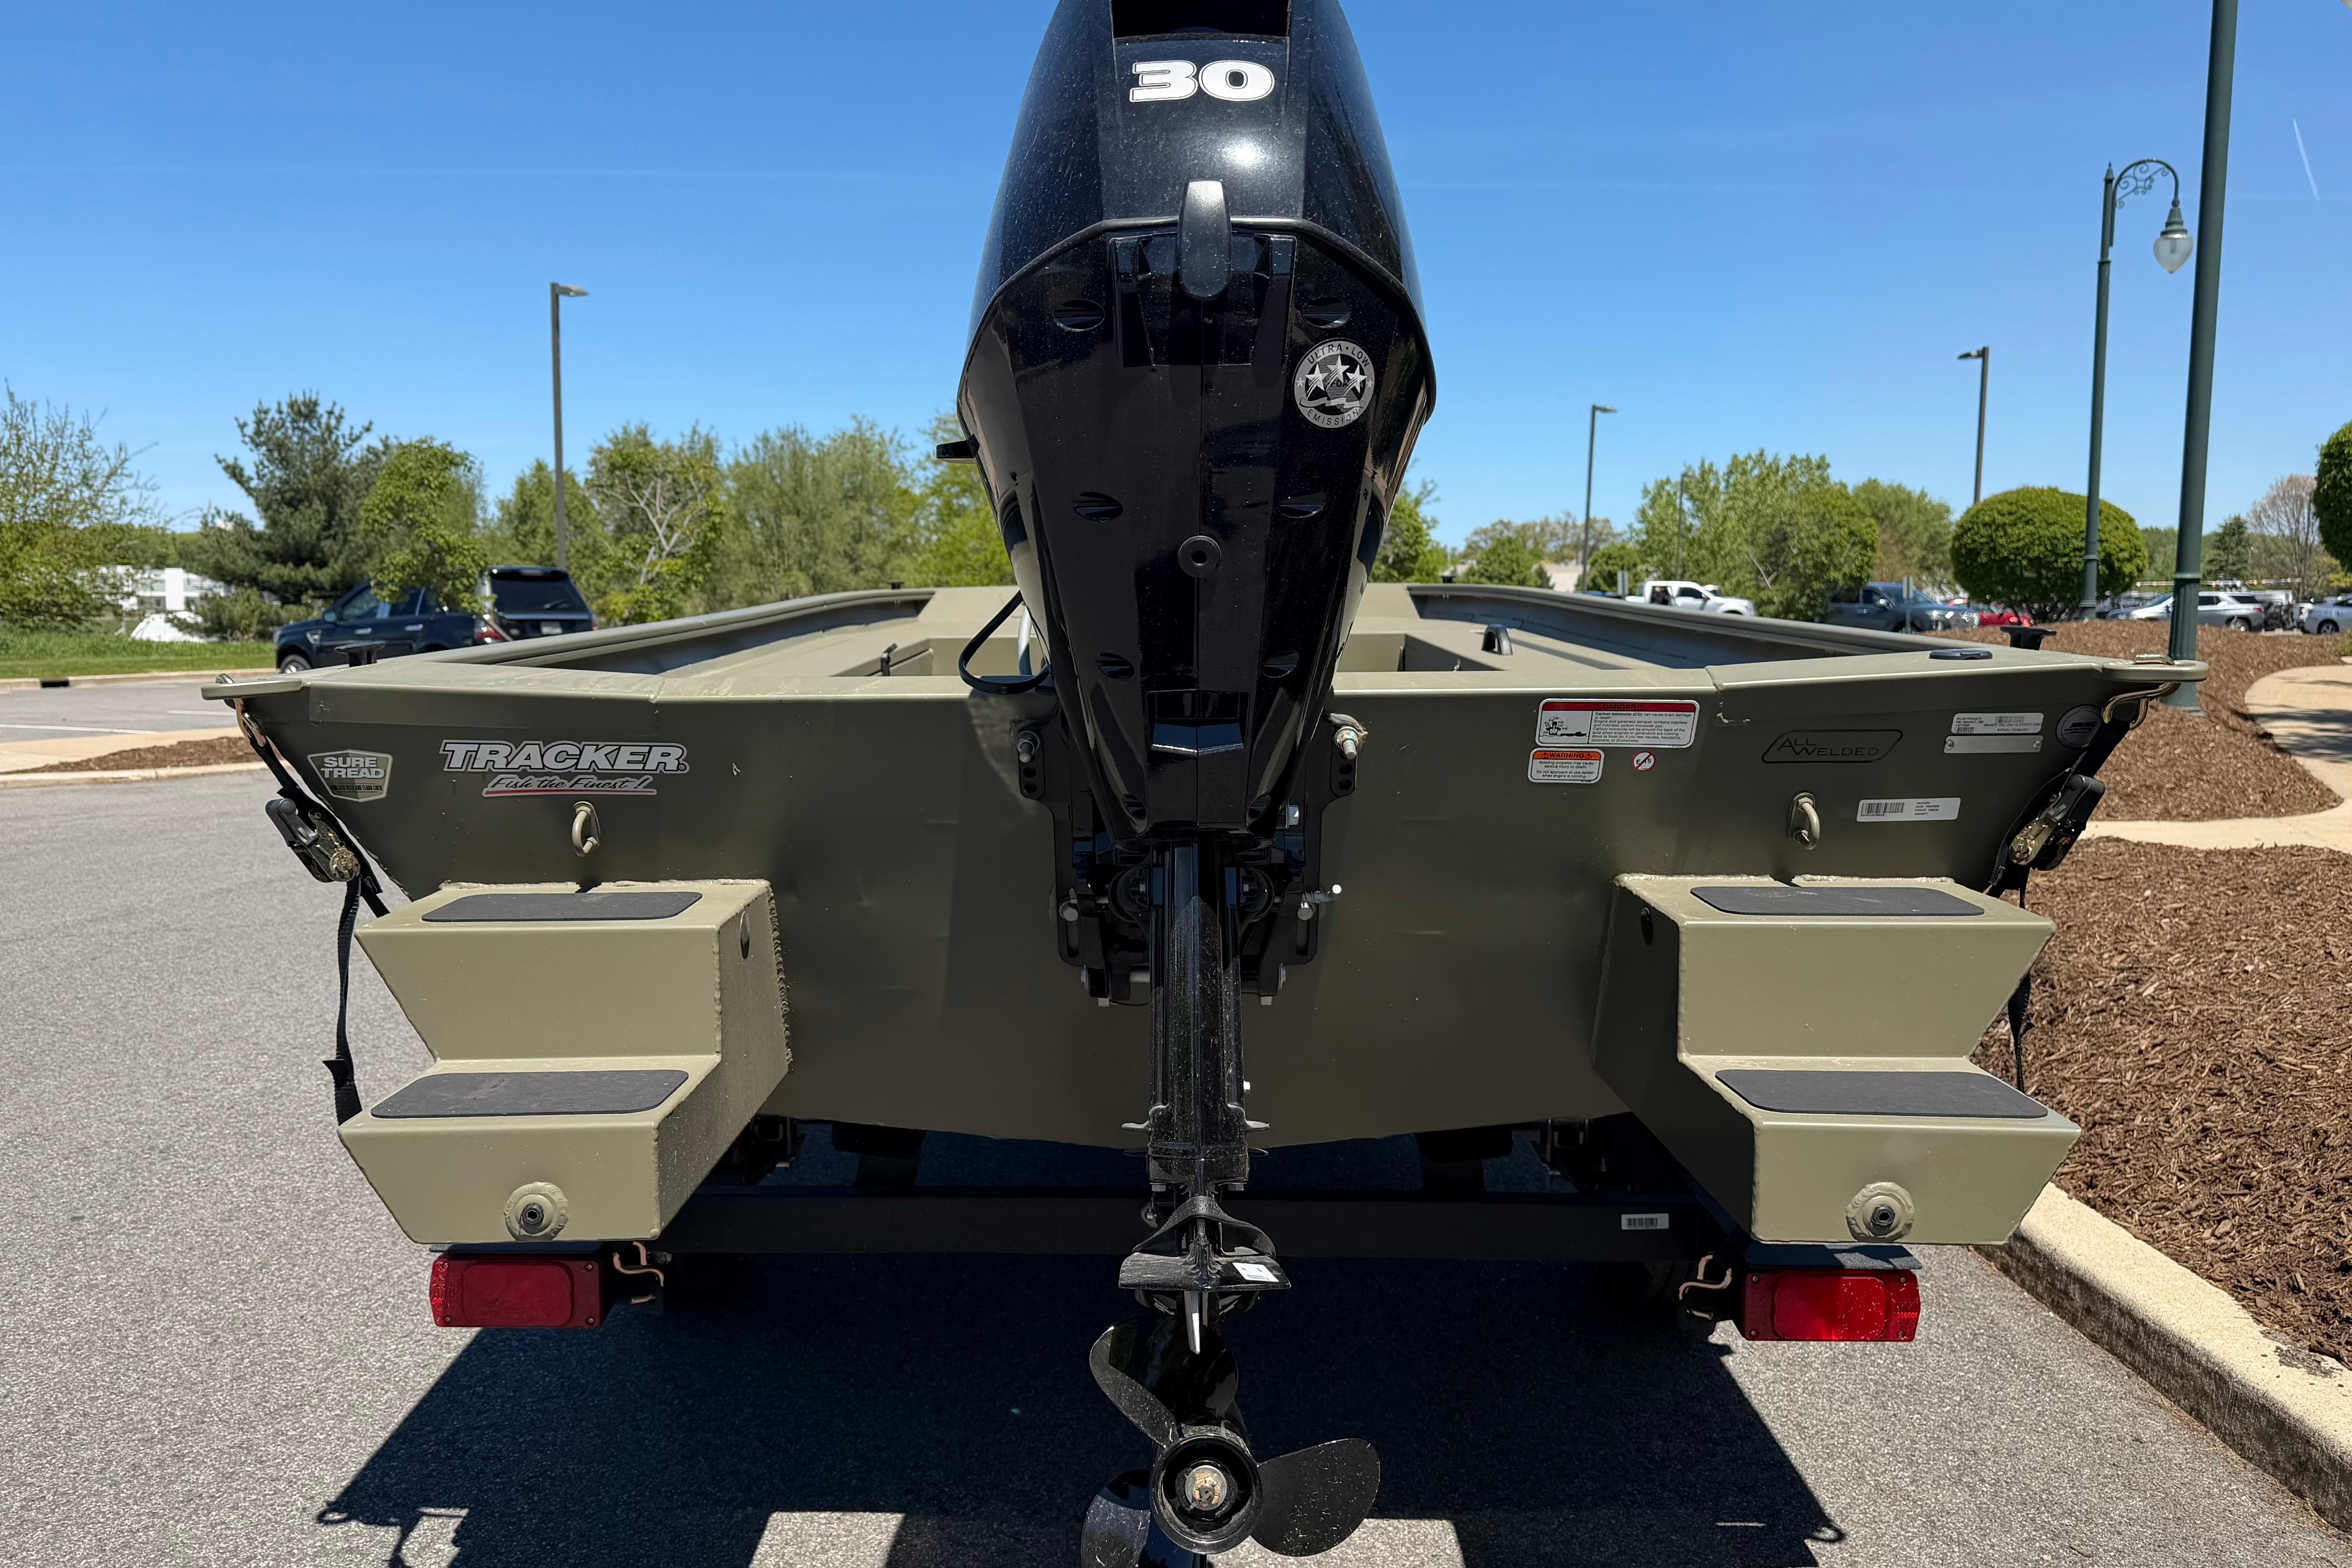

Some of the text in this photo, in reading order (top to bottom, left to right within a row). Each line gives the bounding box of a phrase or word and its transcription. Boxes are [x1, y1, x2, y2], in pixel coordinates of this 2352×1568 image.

[1129, 60, 1275, 102] 30
[1308, 344, 1370, 367] ULTRA LOW
[1308, 409, 1360, 425] EMISSION
[1777, 738, 1816, 751] ALL
[1793, 747, 1879, 755] WELDED
[324, 757, 377, 768] SURE
[443, 742, 679, 771] TRACKER
[321, 768, 385, 779] TREAD
[491, 777, 532, 789] Fish
[537, 777, 565, 788] the
